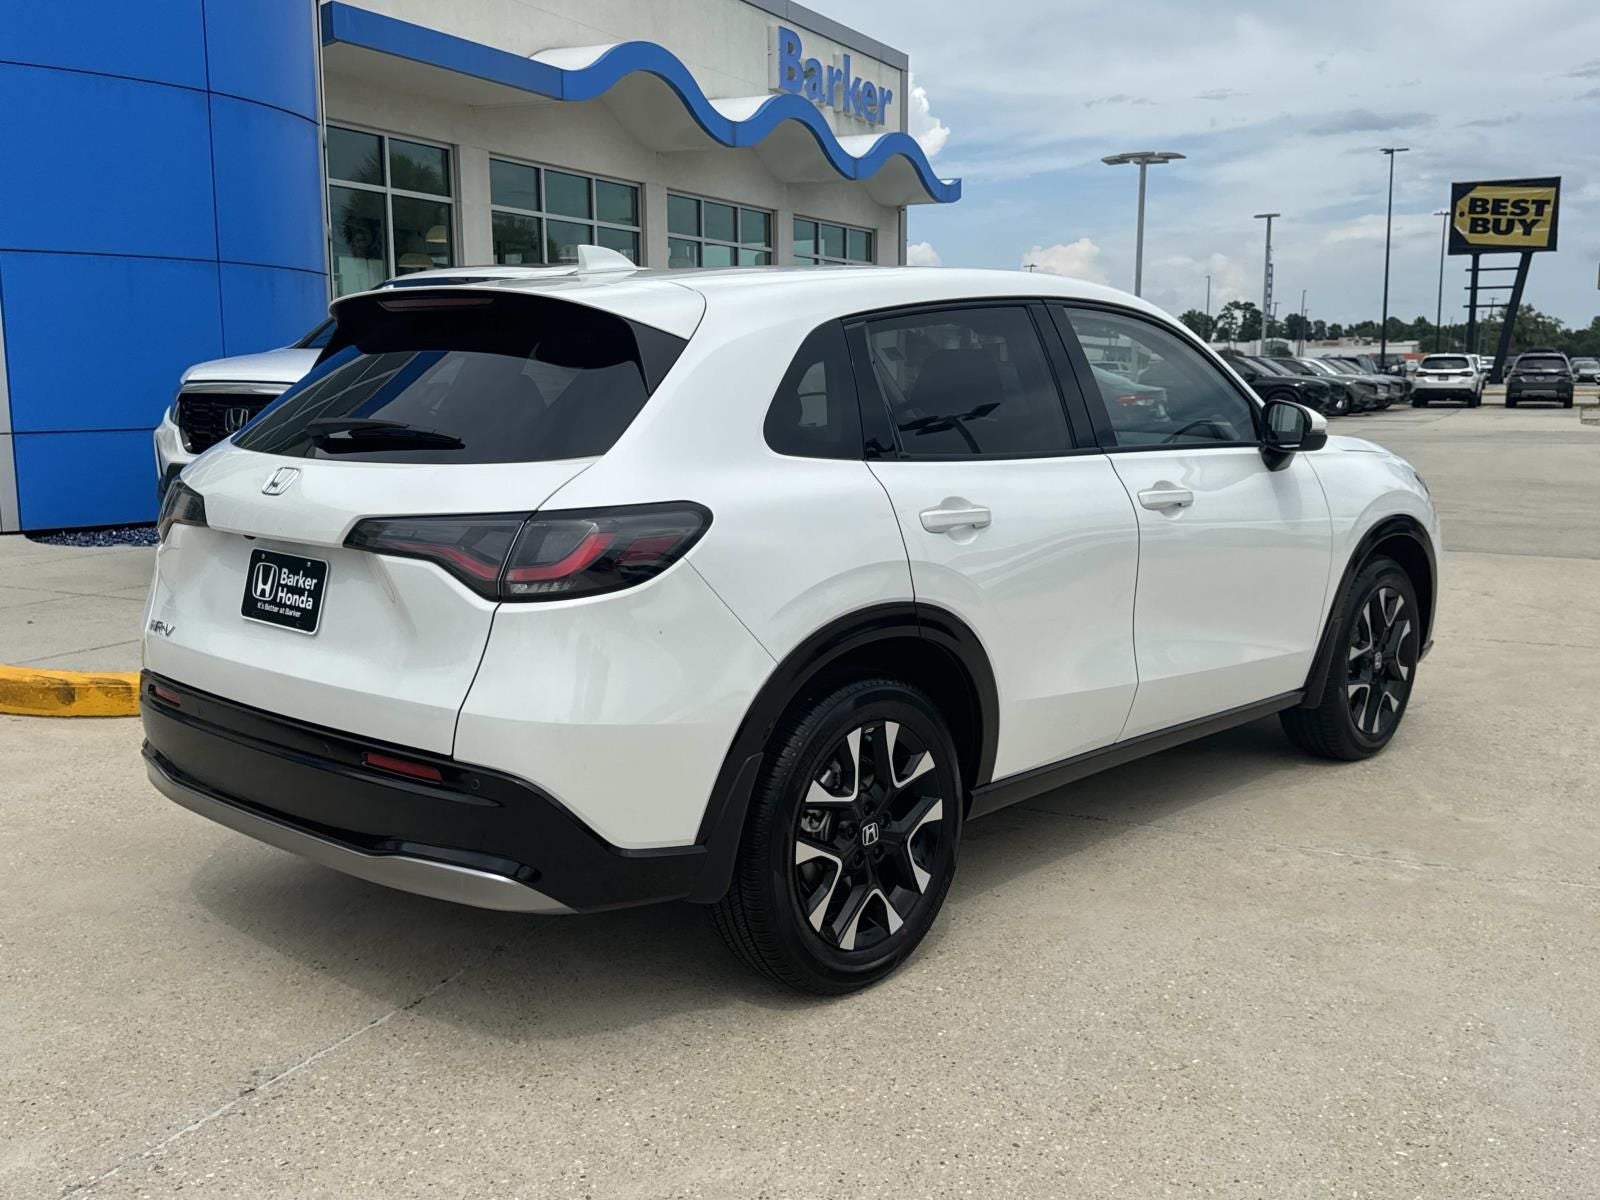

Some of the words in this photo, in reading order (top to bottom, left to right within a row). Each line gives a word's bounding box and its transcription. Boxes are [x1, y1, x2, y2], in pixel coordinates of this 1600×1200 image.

[778, 25, 893, 126] Barker
[1468, 197, 1552, 217] BEST
[1468, 217, 1541, 237] BUY
[280, 568, 317, 590] Barker
[277, 586, 314, 610] Honda
